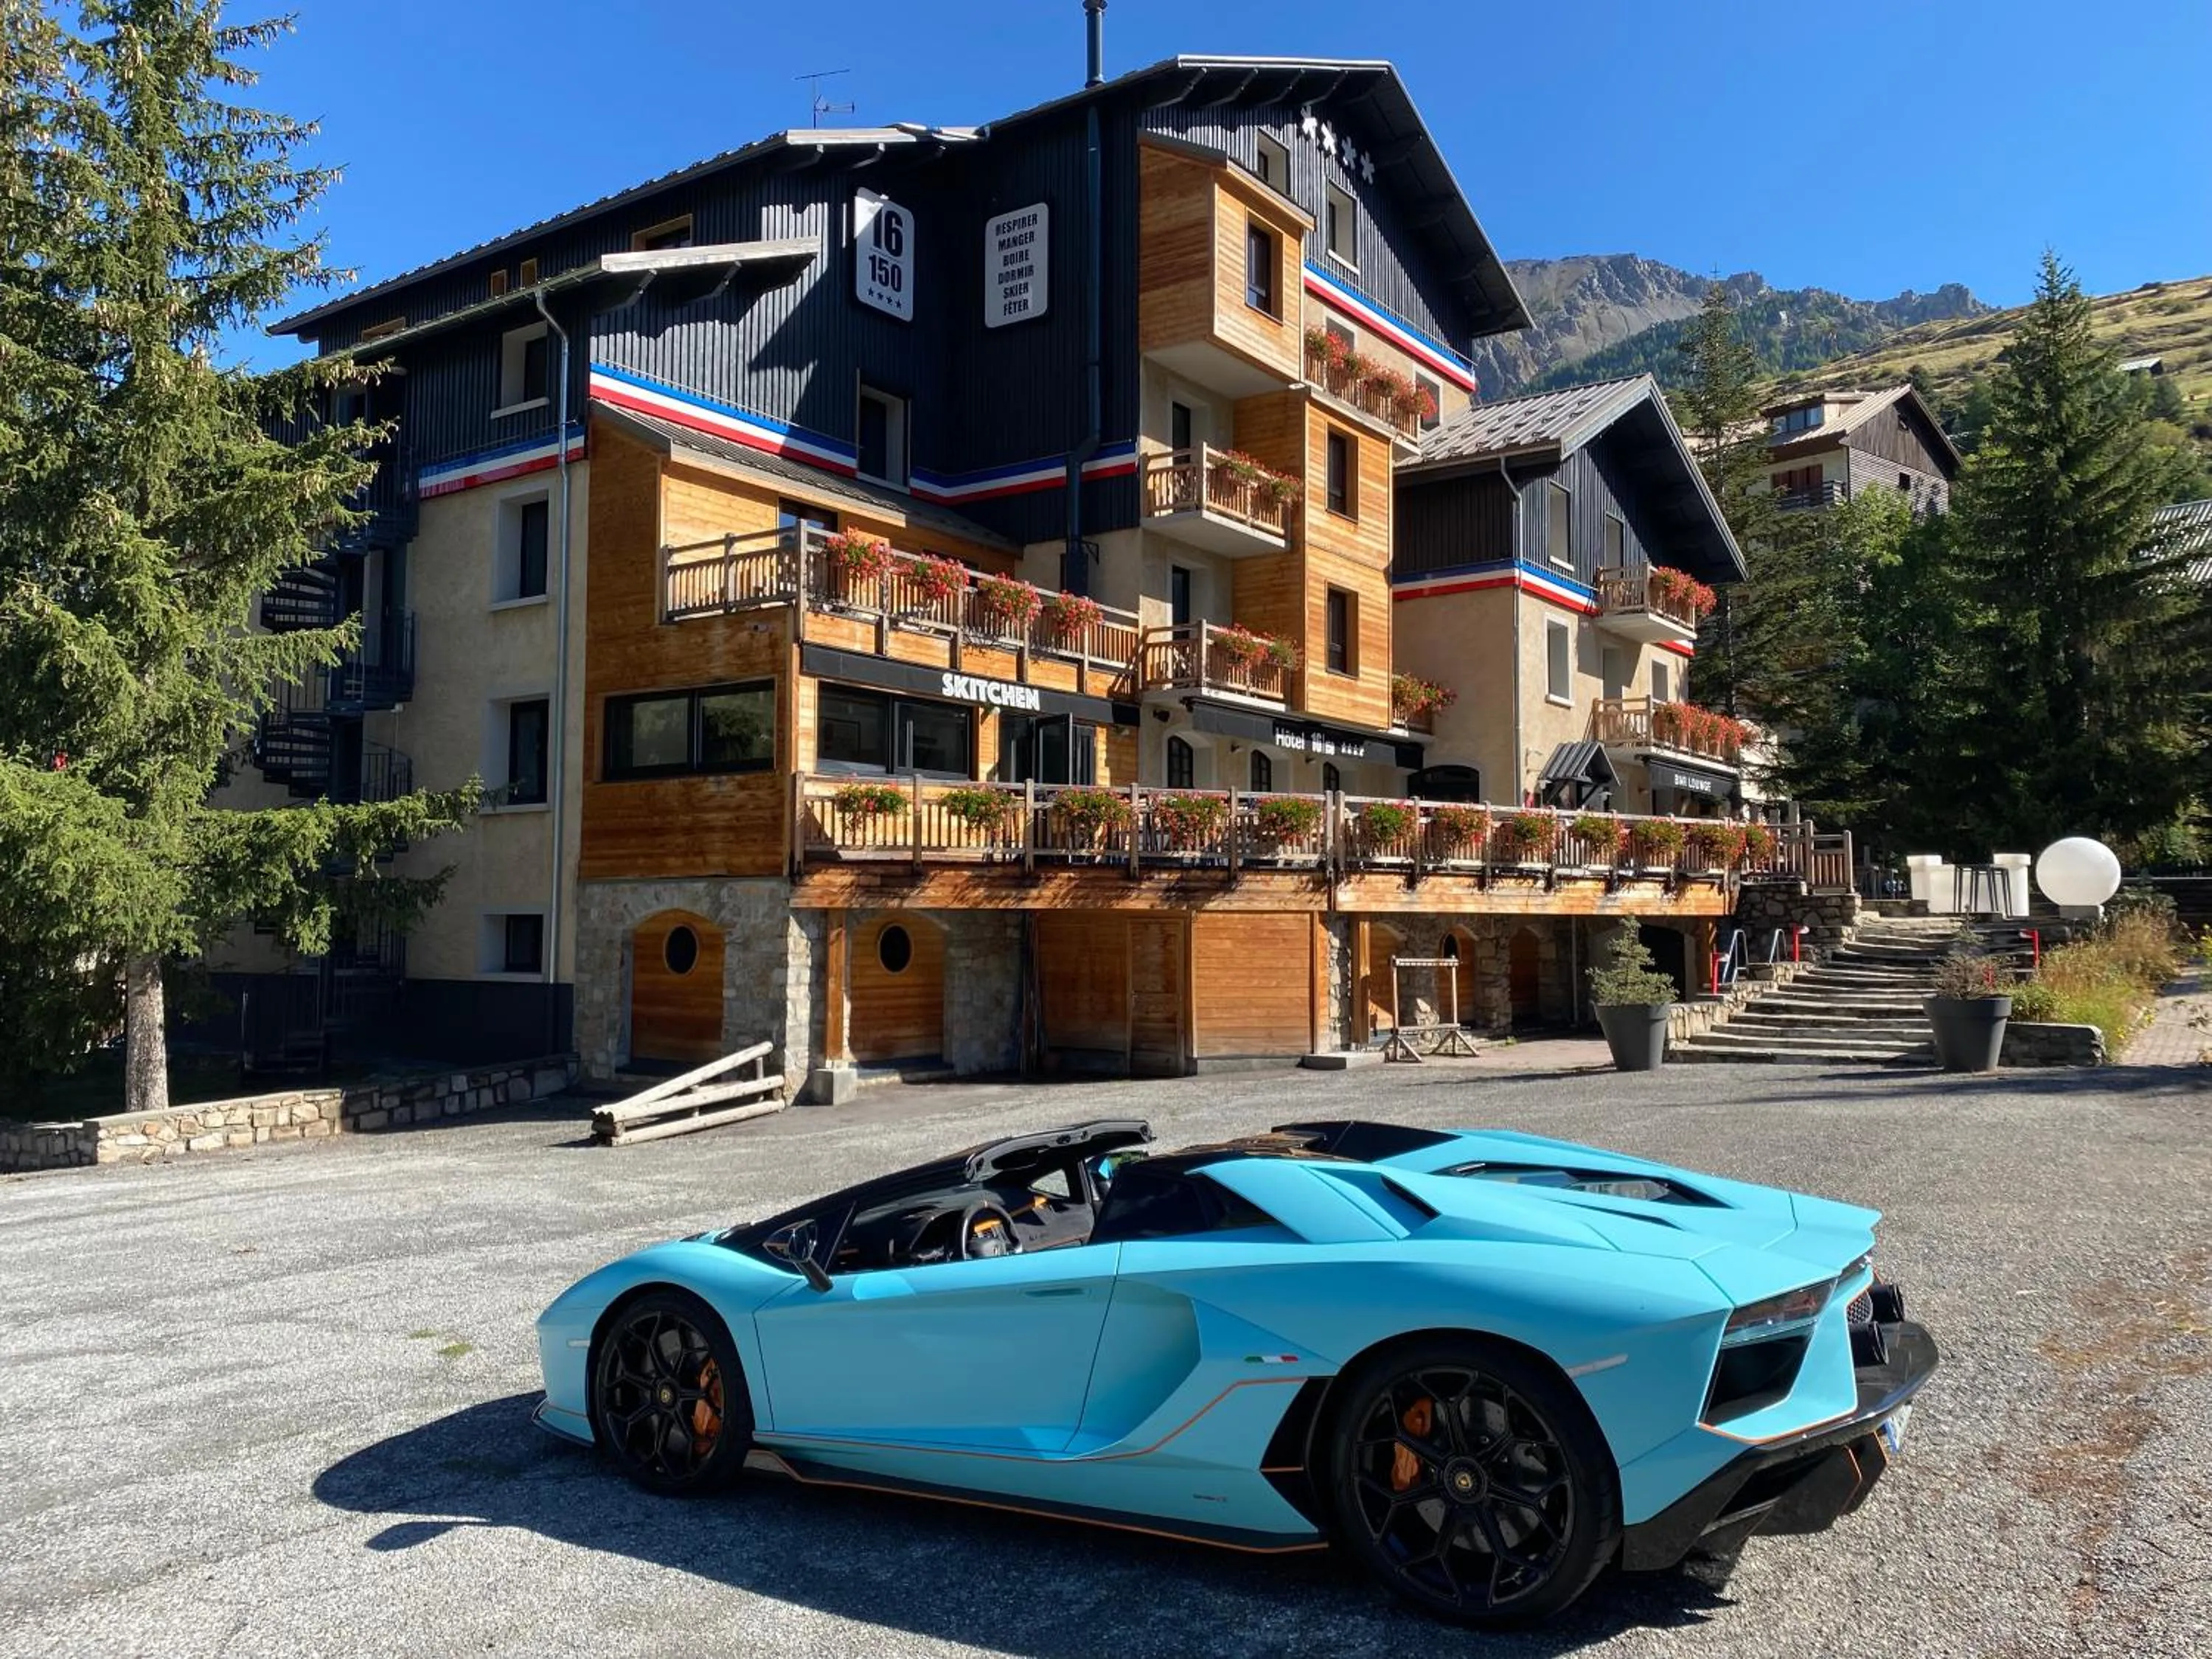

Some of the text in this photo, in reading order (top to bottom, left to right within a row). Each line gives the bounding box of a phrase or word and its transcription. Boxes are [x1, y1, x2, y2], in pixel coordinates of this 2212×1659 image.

[870, 203, 903, 257] 16
[995, 213, 1038, 236] RESPIRER
[998, 231, 1034, 251] MANGER
[1003, 249, 1029, 267] BOIRE
[869, 253, 902, 293] 150
[998, 265, 1034, 285] DORMIR
[1003, 282, 1029, 299] SKIER
[942, 672, 1040, 711] SKITCHEN
[1275, 727, 1305, 751] Hôtel
